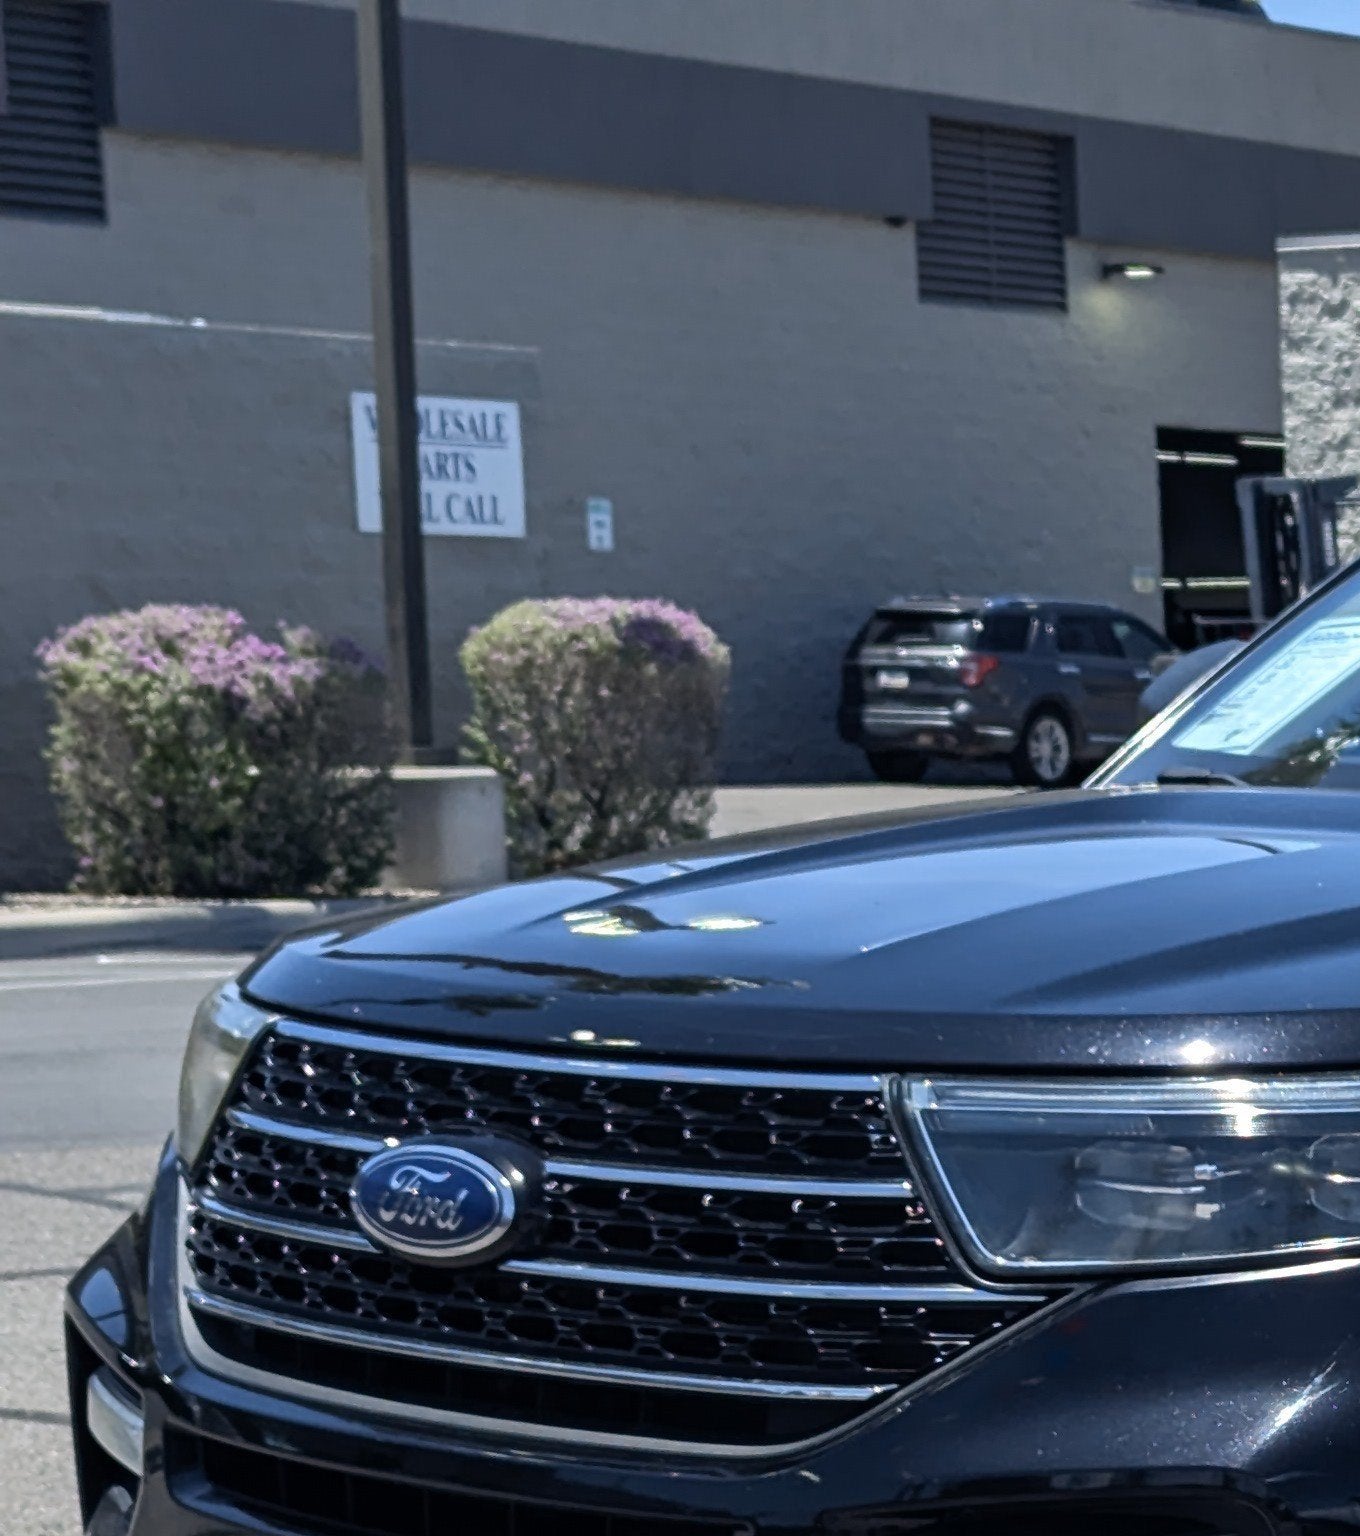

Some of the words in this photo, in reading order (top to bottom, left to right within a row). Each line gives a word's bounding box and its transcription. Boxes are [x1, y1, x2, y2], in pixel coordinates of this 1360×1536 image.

[365, 404, 508, 443] LESALE
[421, 451, 478, 483] ARTS
[444, 492, 506, 527] CALL
[379, 1164, 470, 1231] Ford
